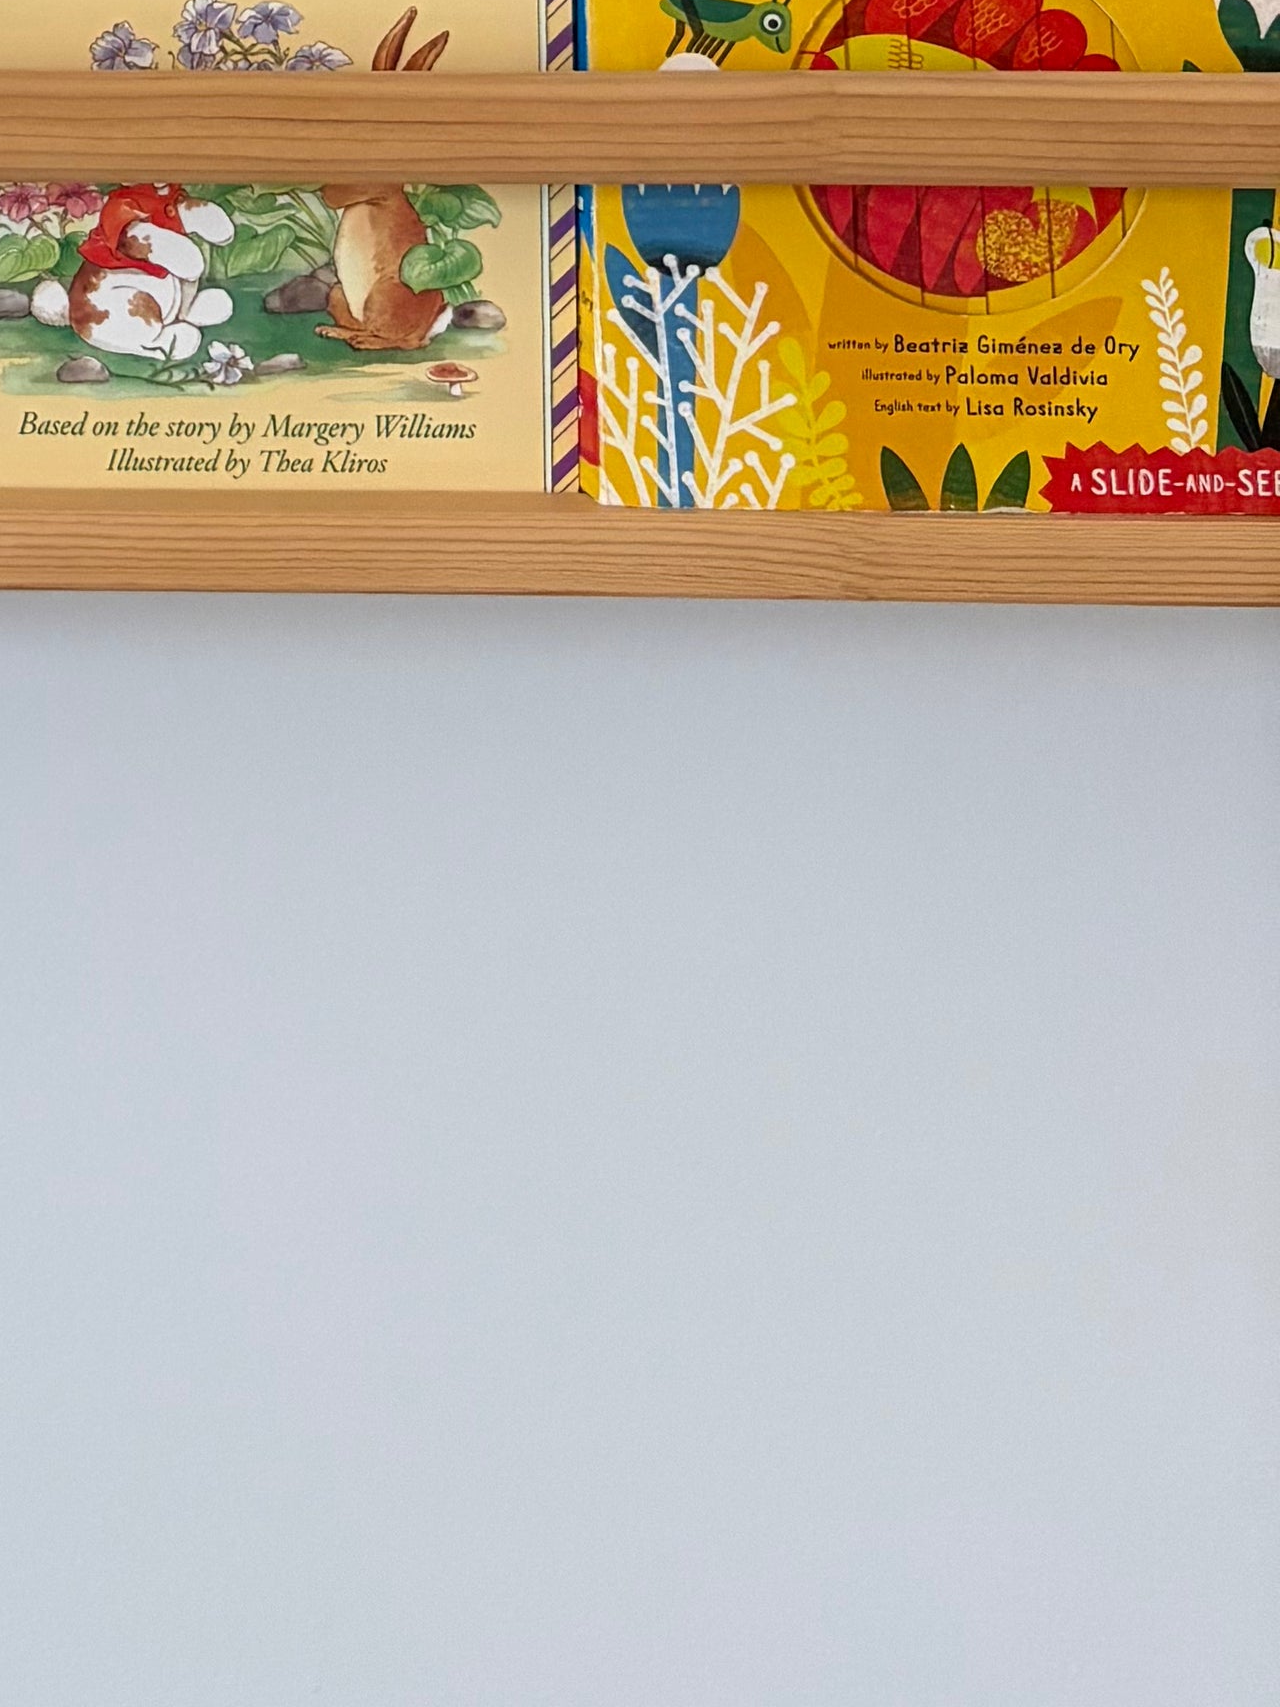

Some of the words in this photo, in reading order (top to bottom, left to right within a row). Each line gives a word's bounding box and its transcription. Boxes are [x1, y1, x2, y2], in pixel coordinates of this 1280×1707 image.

[828, 339, 871, 350] written
[875, 338, 889, 354] by
[894, 334, 968, 354] Beatriz
[977, 334, 1062, 355] Giménez
[1071, 336, 1096, 355] de
[1104, 336, 1140, 362] Ory
[861, 368, 922, 381] illustrated
[927, 369, 940, 385] by
[945, 365, 1018, 386] Paloma
[1027, 365, 1108, 386] Valdivia
[874, 399, 914, 416] English
[917, 401, 941, 412] text
[946, 399, 960, 417] by
[966, 397, 1004, 416] Lisa
[1013, 396, 1098, 424] Rosinsky
[19, 411, 86, 436] Based
[92, 419, 120, 437] on
[127, 412, 160, 437] the
[165, 416, 222, 444] story
[228, 412, 256, 444] by
[261, 414, 365, 446] Margery
[375, 413, 477, 440] Williams
[106, 448, 219, 473] Illustrated
[225, 448, 250, 479] by
[260, 449, 314, 474] Thea
[321, 449, 388, 474] Kliros
[1071, 473, 1082, 492] A
